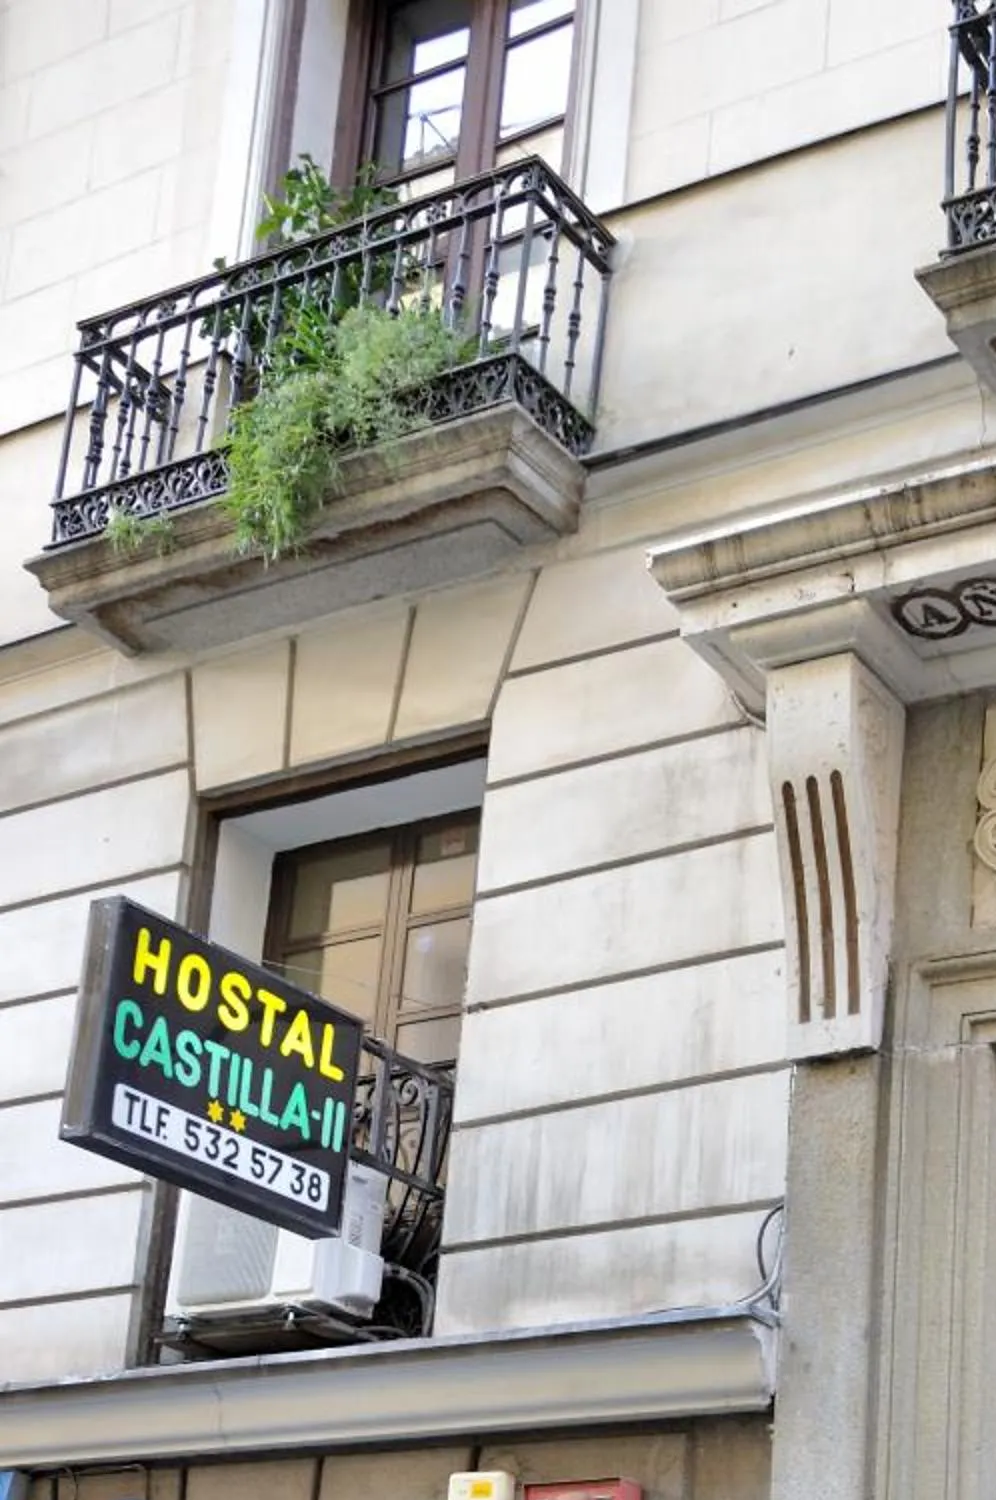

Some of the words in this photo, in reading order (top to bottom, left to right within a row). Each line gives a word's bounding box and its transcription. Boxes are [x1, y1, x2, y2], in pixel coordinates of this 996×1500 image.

[113, 999, 346, 1154] CASTILLA-II
[132, 927, 345, 1082] HOSTAL
[183, 1120, 239, 1170] 532
[250, 1151, 283, 1192] 57
[289, 1164, 323, 1203] 38
